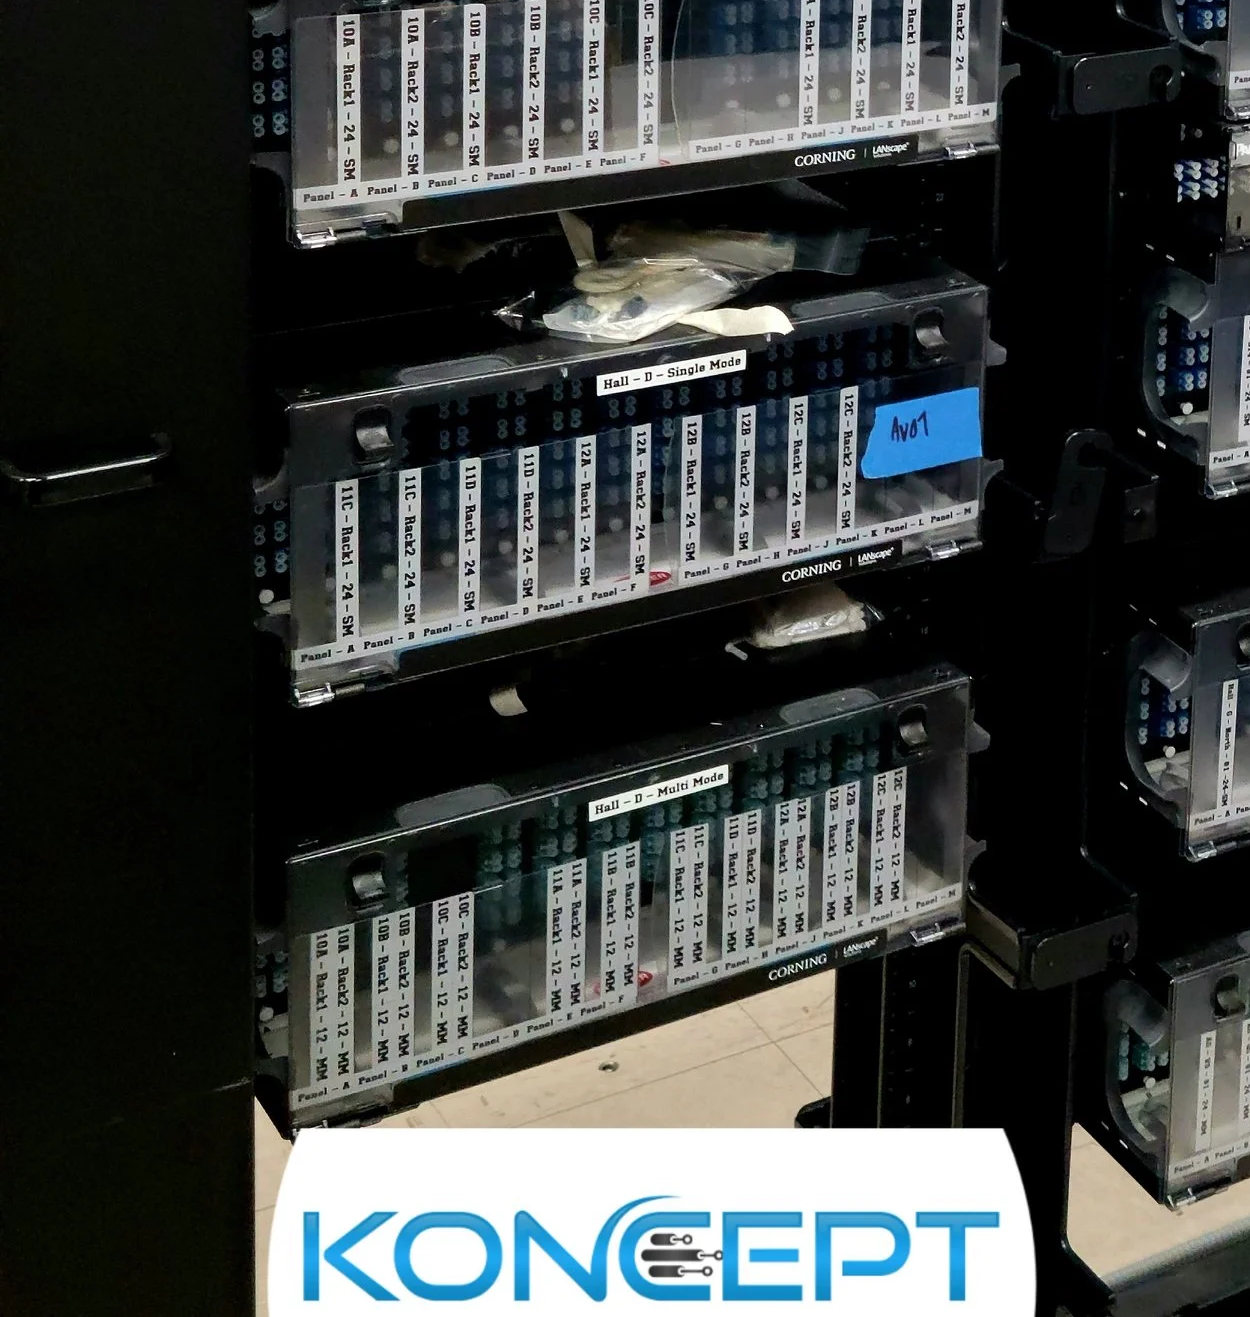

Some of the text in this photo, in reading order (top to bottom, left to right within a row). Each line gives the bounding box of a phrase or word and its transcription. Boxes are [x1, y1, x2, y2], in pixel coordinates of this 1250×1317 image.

[804, 19, 815, 58] Rack1
[803, 74, 814, 91] 24
[342, 19, 356, 181] 10A Rack1 24 SM
[802, 105, 813, 126] SM
[793, 148, 856, 167] CORNING
[302, 187, 358, 203] Panel A
[603, 356, 741, 389] Hall D Single Mode
[634, 430, 646, 575] 12A Rack2 24 SM
[340, 485, 354, 637] 11C Rack1 24 SM
[683, 565, 710, 579] Panel
[722, 561, 729, 571] G
[781, 559, 841, 582] CORNING
[594, 771, 724, 815] Hall D Multi Mode
[456, 893, 469, 1039] 10C Rack2 12 MM
[767, 952, 827, 981] CORNING
[297, 1080, 350, 1103] Panel A
